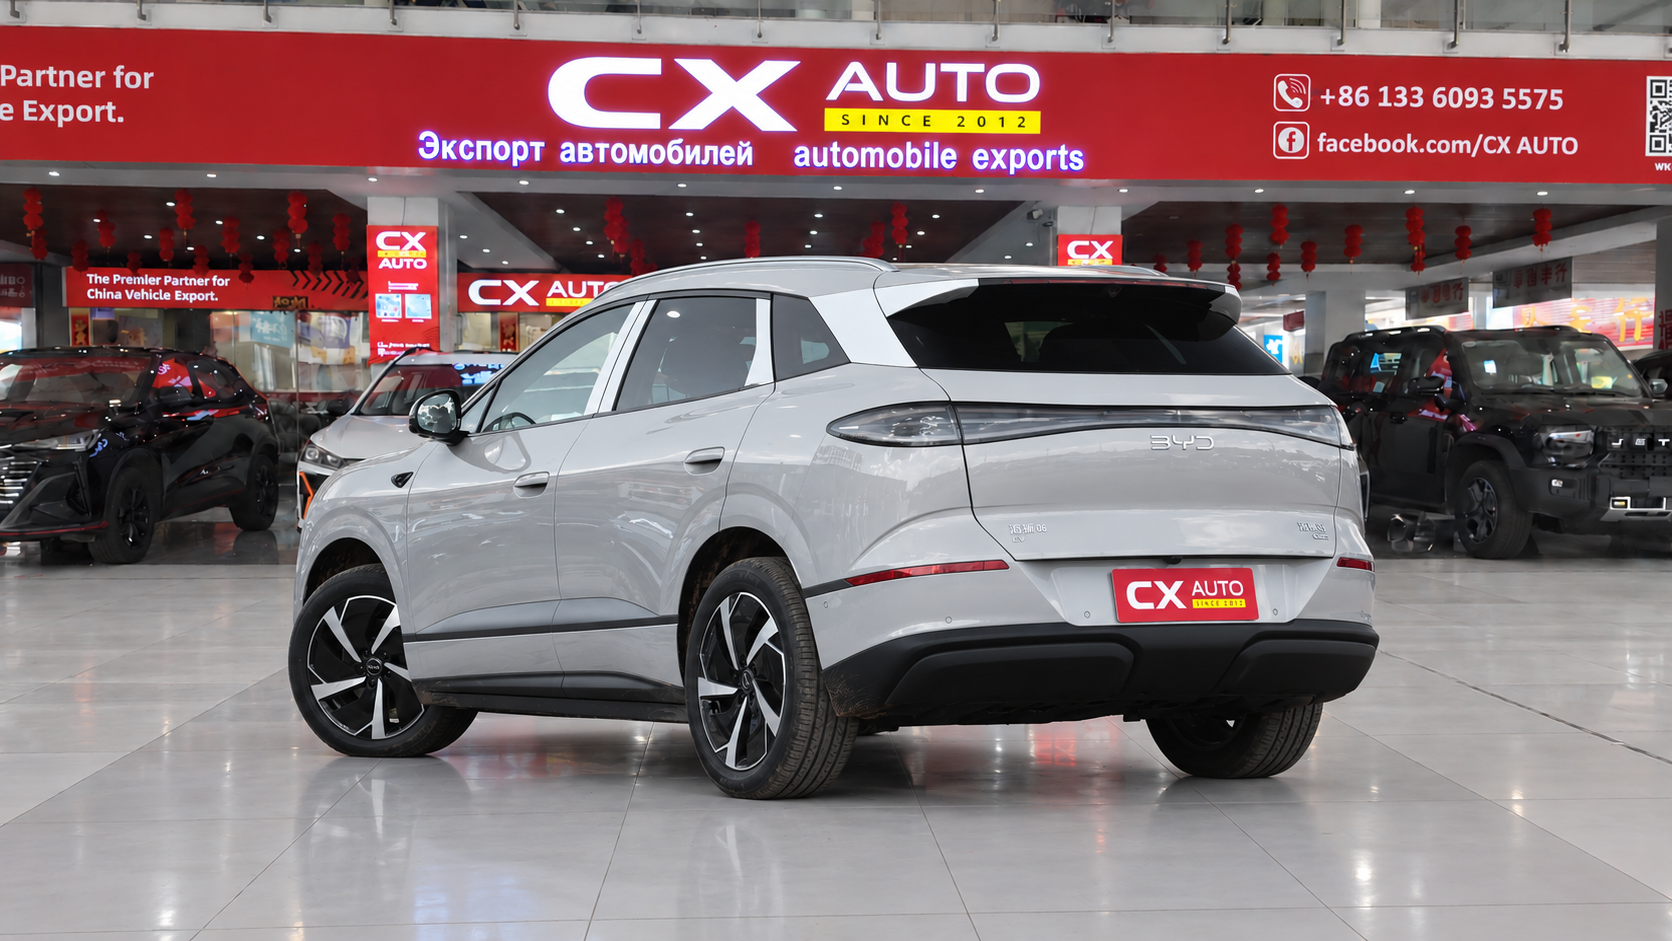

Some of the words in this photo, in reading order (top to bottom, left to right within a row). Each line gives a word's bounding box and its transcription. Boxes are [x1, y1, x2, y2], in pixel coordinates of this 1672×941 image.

[0, 65, 106, 89] Partner
[113, 65, 155, 89] for
[547, 57, 800, 132] CX
[825, 62, 1041, 103] AUTO
[1320, 85, 1370, 107] +86
[1378, 86, 1424, 107] 133
[1432, 86, 1495, 109] 6093
[1502, 88, 1564, 110] 5575
[23, 100, 125, 128] Export.
[841, 113, 932, 128] SINCE
[956, 115, 1027, 129] 2012
[418, 130, 546, 167] Экспорт
[559, 139, 753, 166] автомобилей
[1316, 132, 1511, 158] facebook.com/CX
[1516, 136, 1579, 156] AUTO
[793, 141, 957, 170] automobile
[972, 145, 1084, 175] exports
[375, 230, 427, 251] CX
[1066, 240, 1114, 260] CX
[378, 257, 428, 270] AUTO
[86, 273, 110, 284] The
[163, 275, 210, 287] Partner
[211, 275, 231, 287] for
[86, 288, 123, 300] China
[124, 288, 172, 301] Vehicle
[174, 290, 219, 304] Export.
[468, 279, 540, 307] CX
[1150, 435, 1215, 450] BYD
[1126, 580, 1187, 610] CX
[1191, 580, 1244, 597] AUTO
